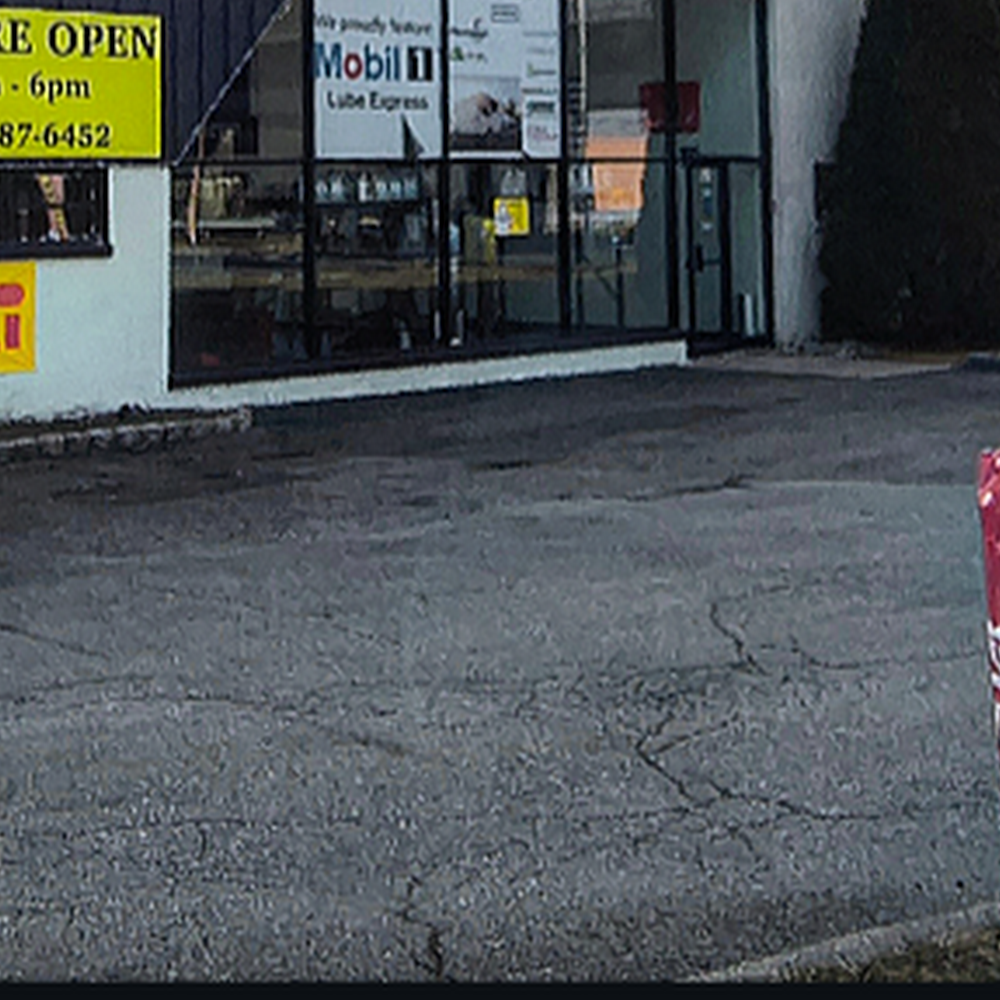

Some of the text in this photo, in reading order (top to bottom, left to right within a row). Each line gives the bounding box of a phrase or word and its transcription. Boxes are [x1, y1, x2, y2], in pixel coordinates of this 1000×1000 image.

[48, 22, 158, 58] OPEN
[315, 43, 401, 81] Mobil
[407, 47, 433, 81] 1
[30, 71, 90, 105] 6pm
